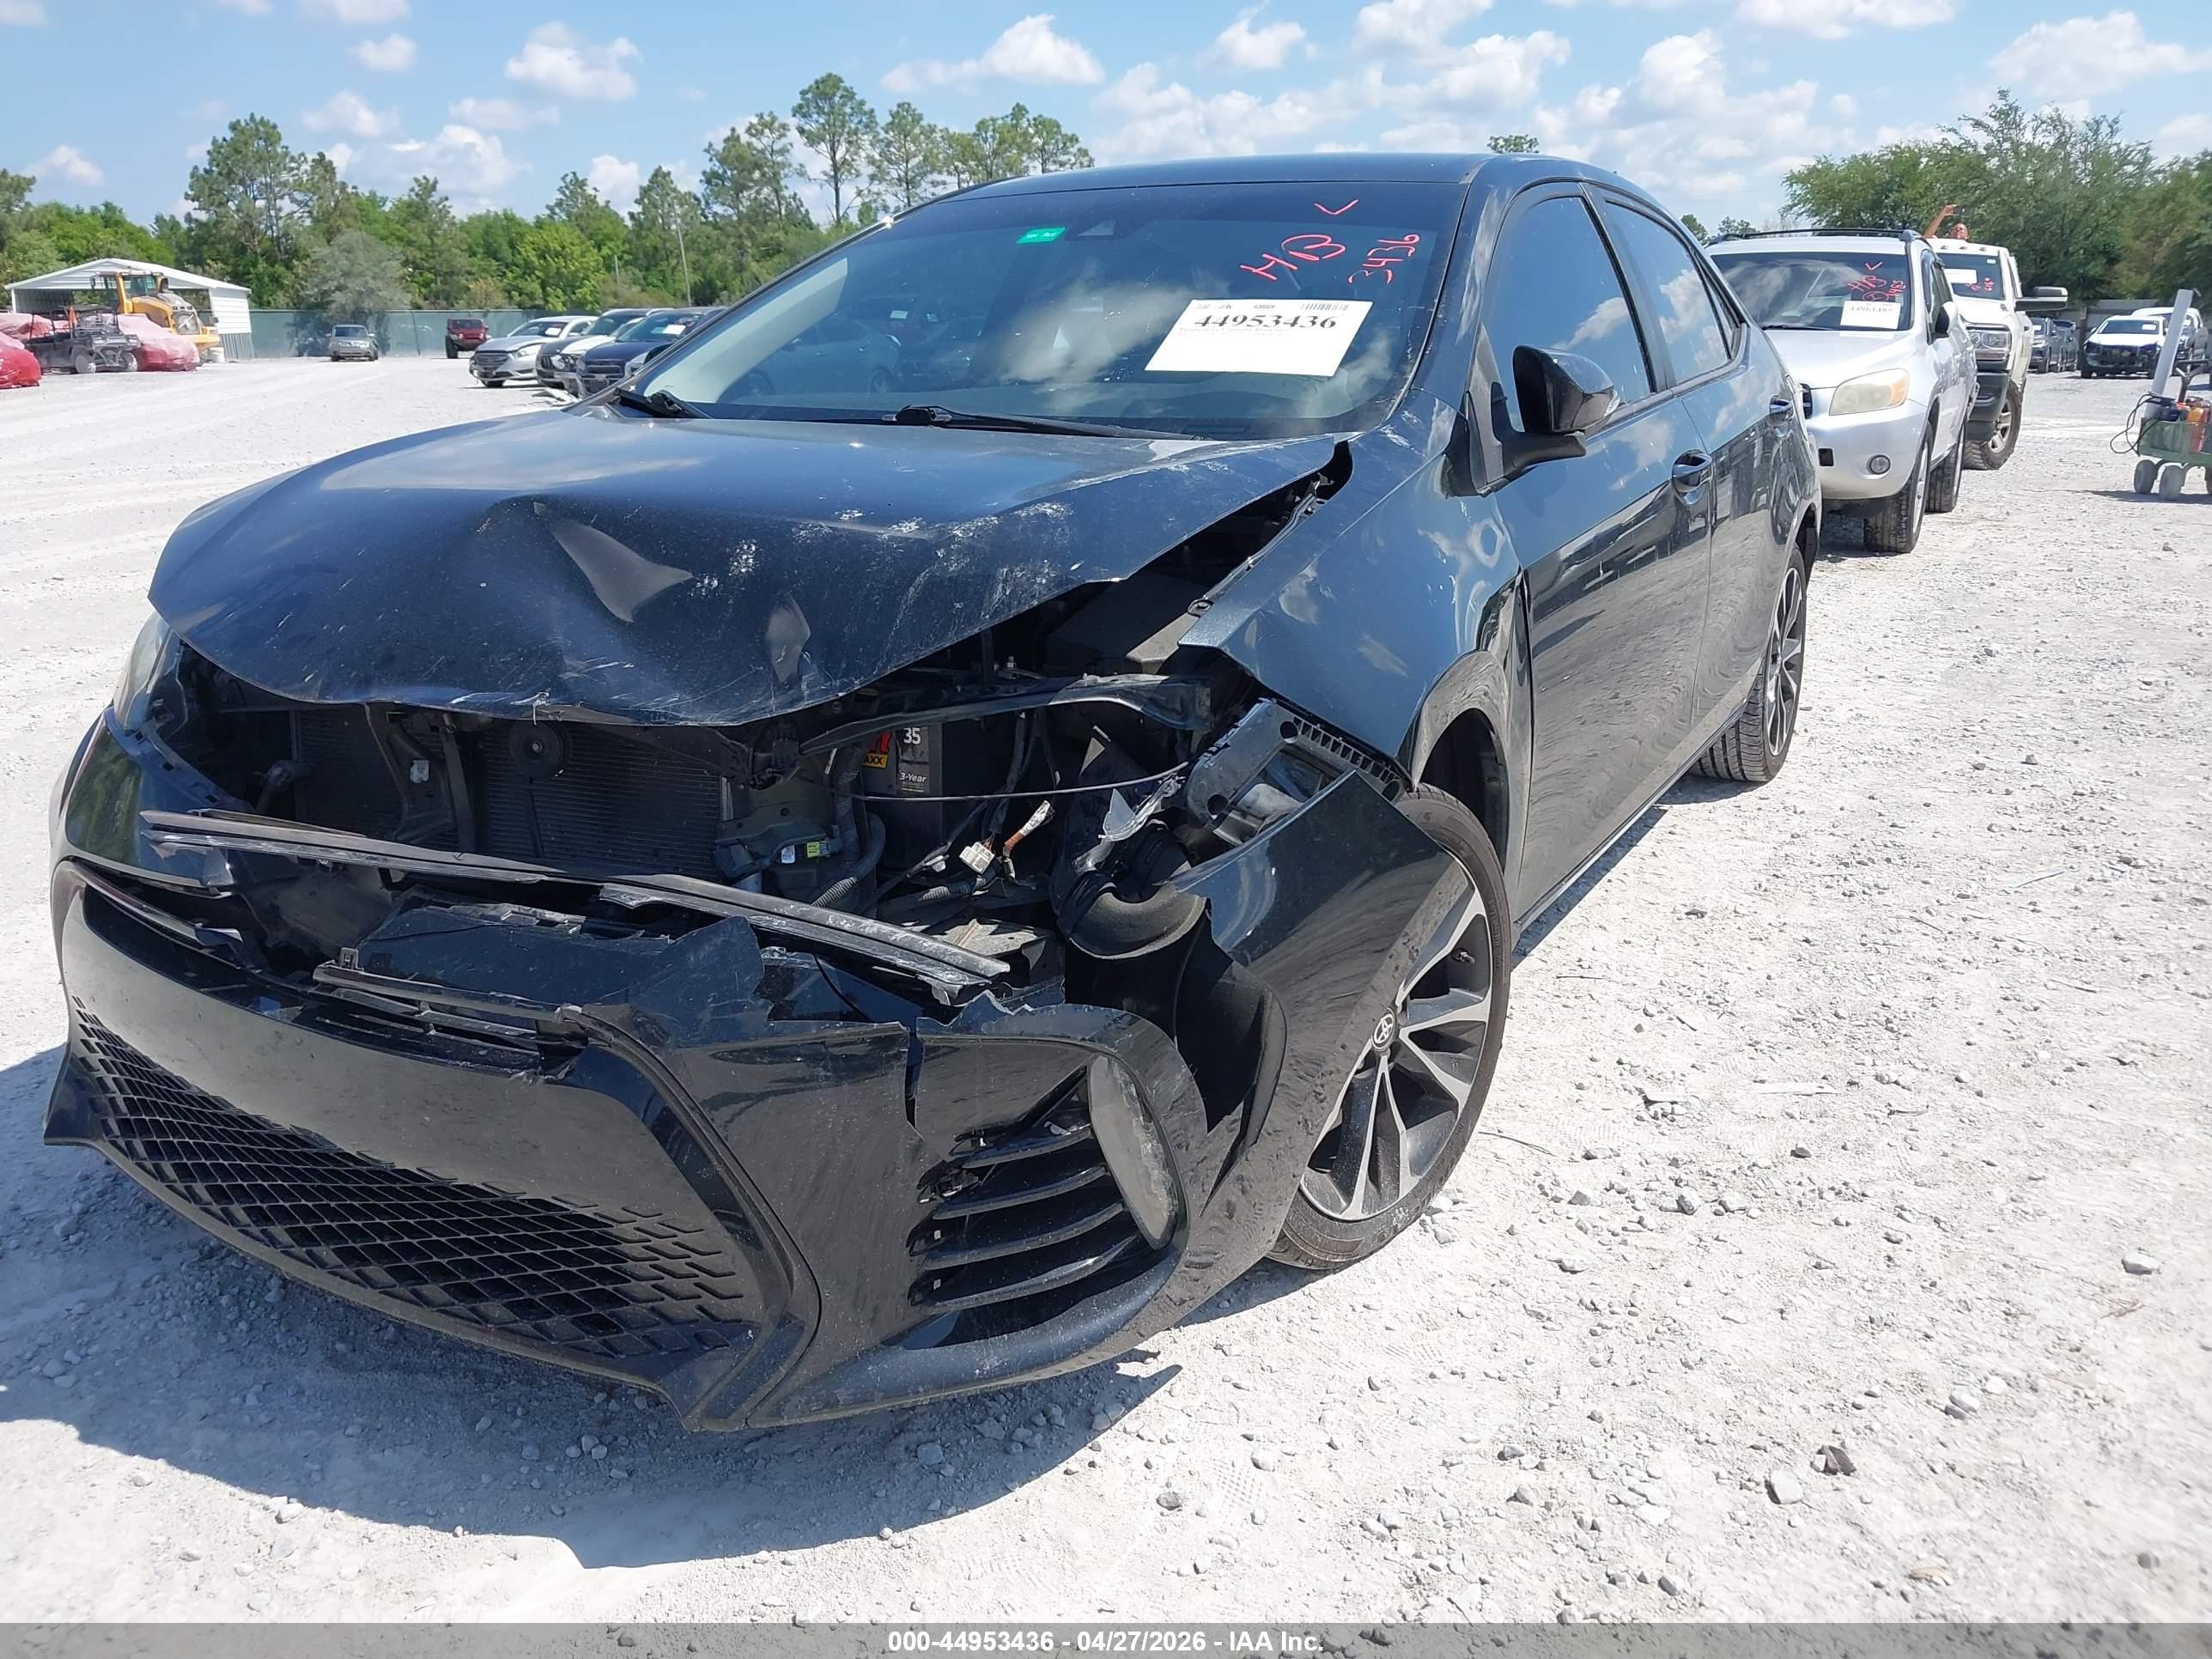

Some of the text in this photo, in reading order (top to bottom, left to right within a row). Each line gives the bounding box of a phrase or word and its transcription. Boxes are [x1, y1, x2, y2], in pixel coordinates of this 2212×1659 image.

[1194, 313, 1337, 329] 44953436
[902, 726, 921, 745] 35
[865, 754, 884, 765] AXX
[899, 772, 927, 783] 3-Year
